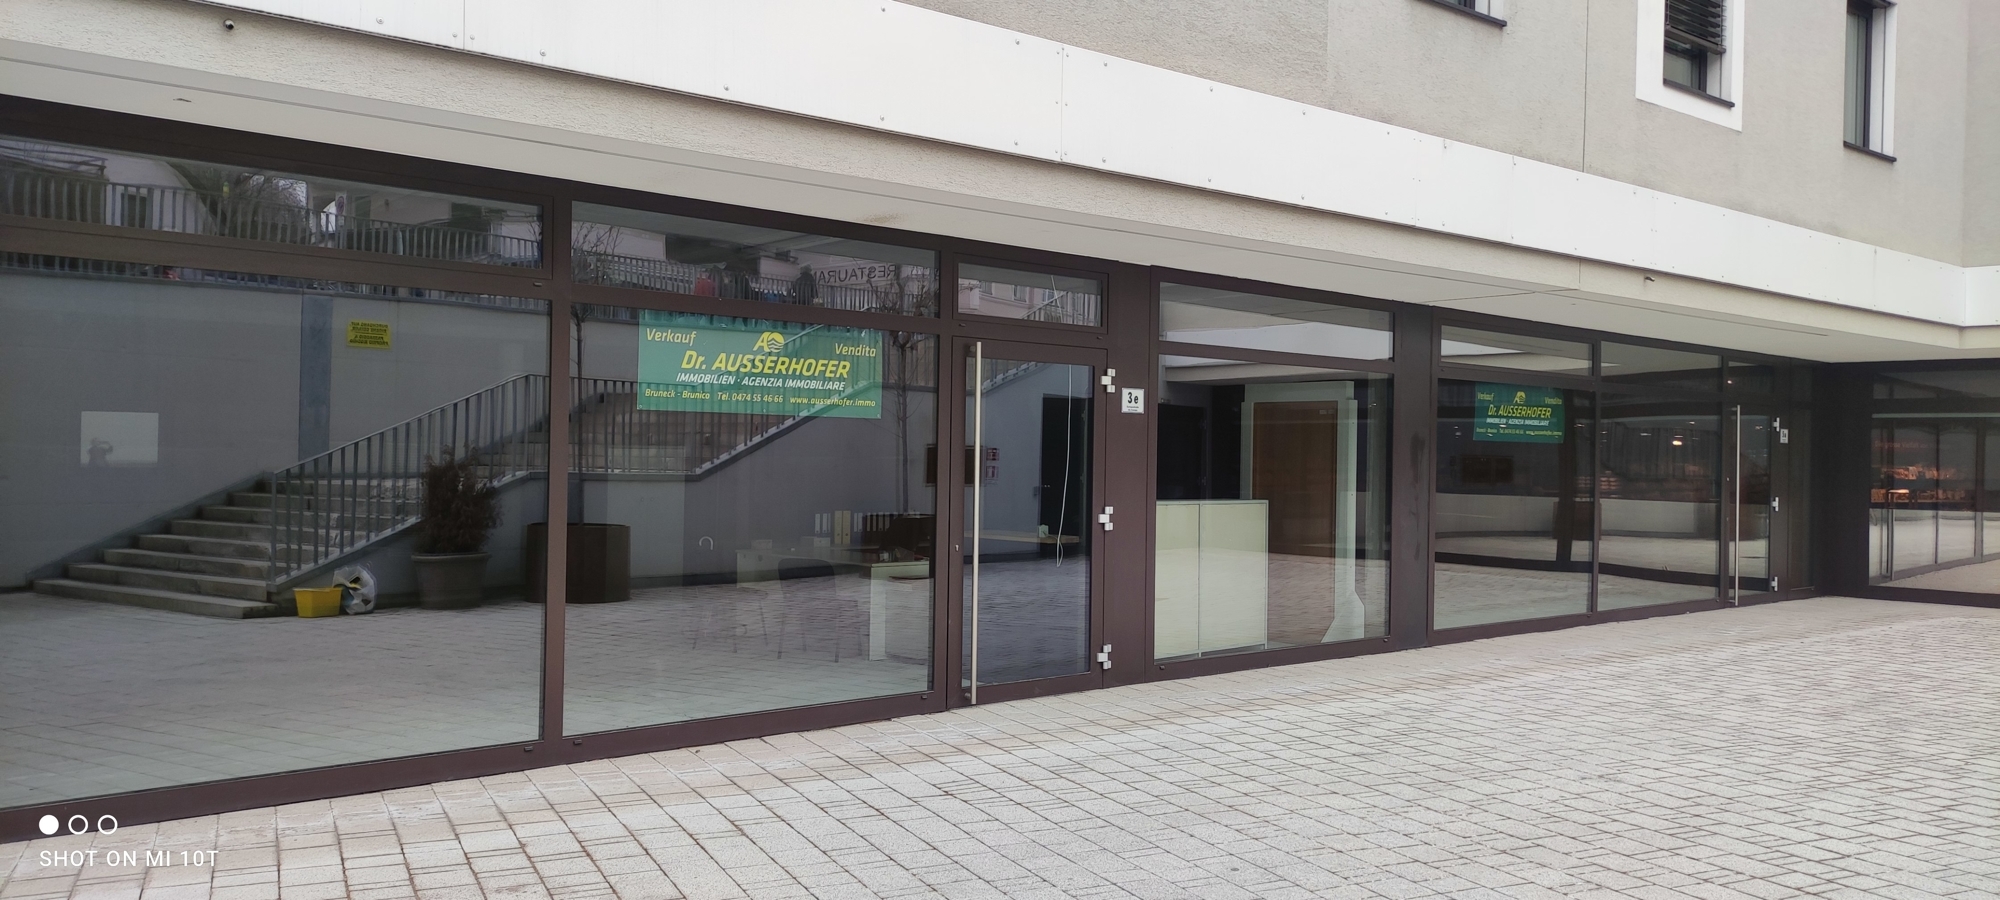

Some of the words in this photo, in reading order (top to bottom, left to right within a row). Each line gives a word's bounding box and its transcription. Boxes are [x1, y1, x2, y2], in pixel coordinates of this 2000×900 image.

[646, 328, 697, 346] Verkauf
[835, 343, 876, 357] Vendita
[681, 350, 706, 369] Dr.
[711, 352, 850, 378] AUSSERHOFER
[676, 373, 735, 385] IMMOBILIEN
[742, 376, 782, 387] AGENZIA
[784, 379, 845, 390] IMMOBILIARE
[645, 388, 675, 398] Bruneck
[682, 391, 710, 399] Brunico
[718, 392, 730, 400] Tel.
[732, 393, 751, 401] 0474
[753, 393, 762, 402] 55
[1477, 392, 1494, 402] Verkauf
[790, 396, 876, 407] www.ausserhofer.immo
[1488, 404, 1496, 415] Dr.
[1498, 405, 1551, 418] AUSSERHOFER
